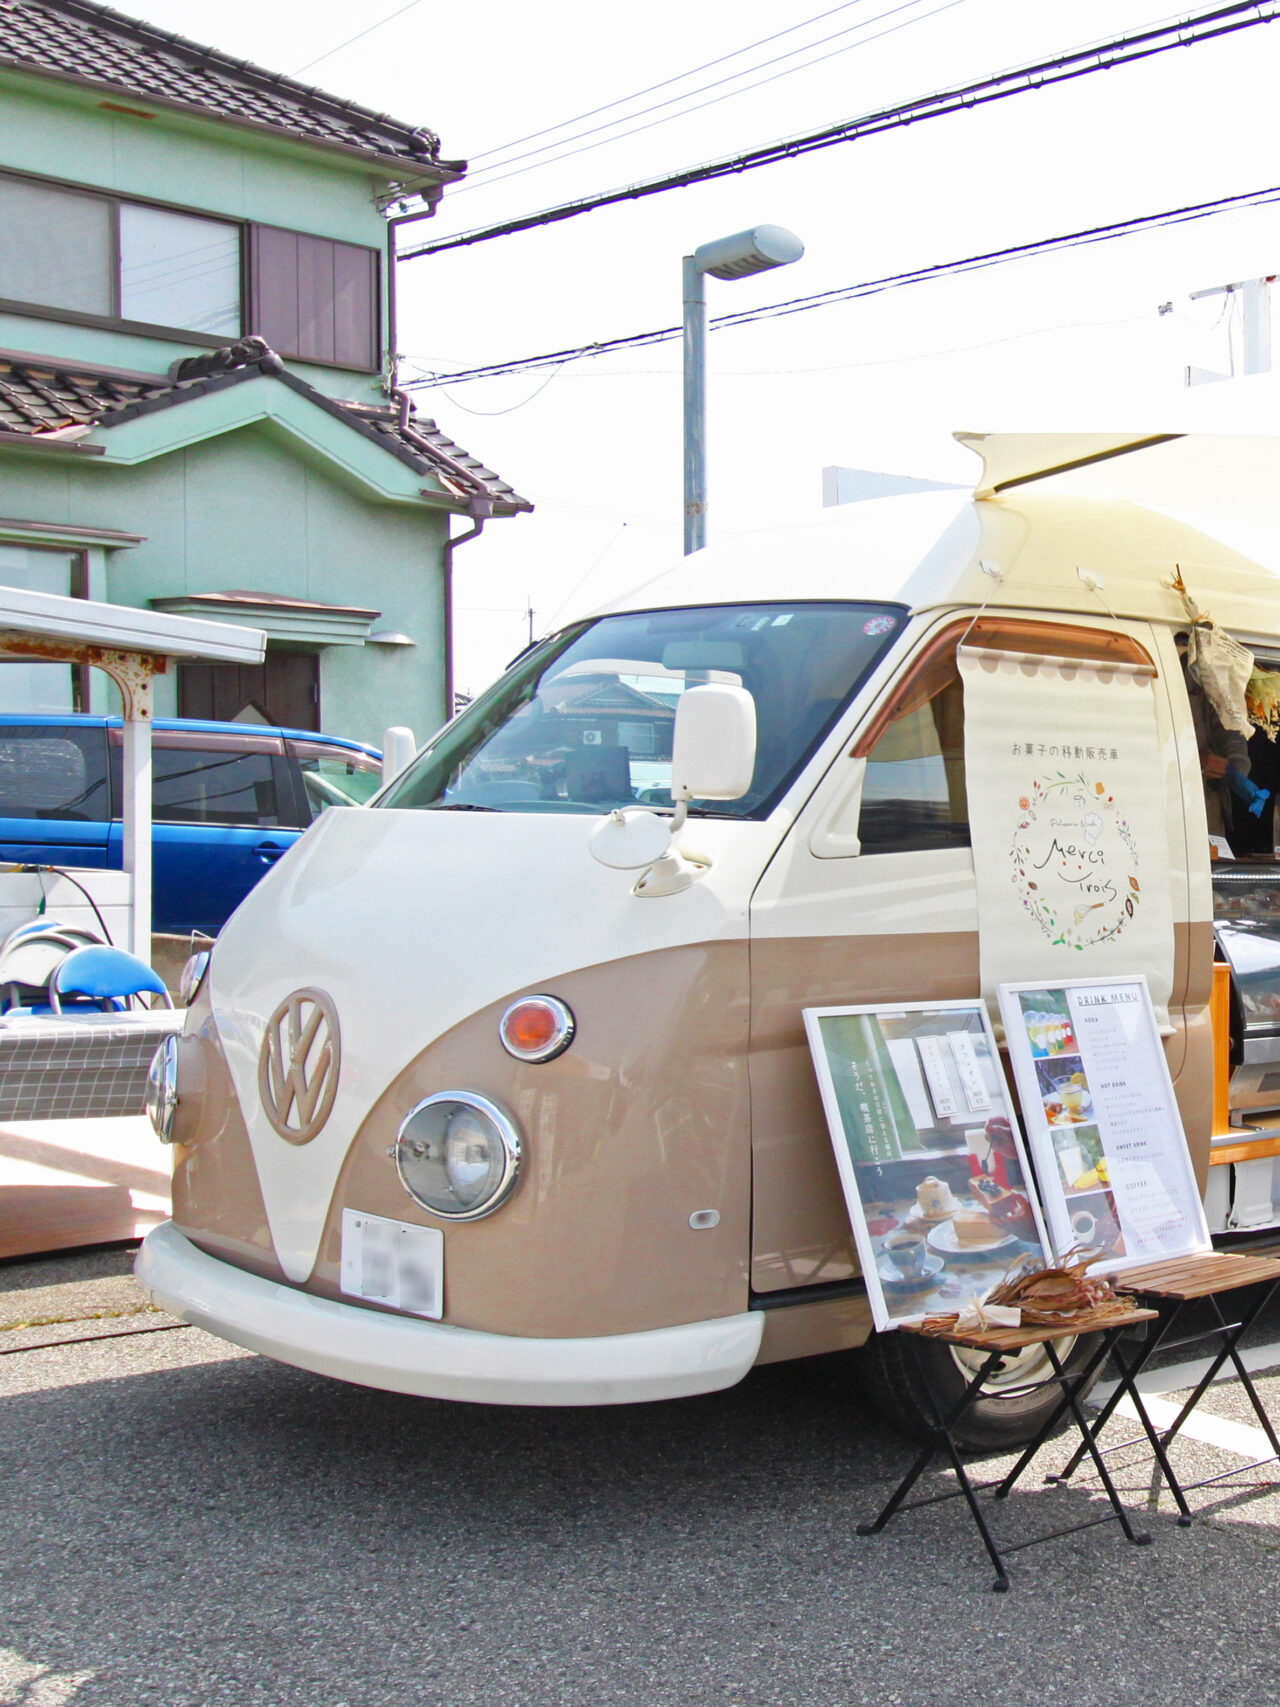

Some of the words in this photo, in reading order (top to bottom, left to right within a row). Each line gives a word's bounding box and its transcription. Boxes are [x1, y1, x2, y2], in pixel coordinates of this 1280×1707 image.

[1011, 742, 1119, 761] お菓子の移動販売車
[1033, 838, 1106, 869] Merci
[1077, 994, 1108, 1006] DRINK
[1110, 991, 1138, 1003] MENU
[1125, 1180, 1147, 1190] COFFEE
